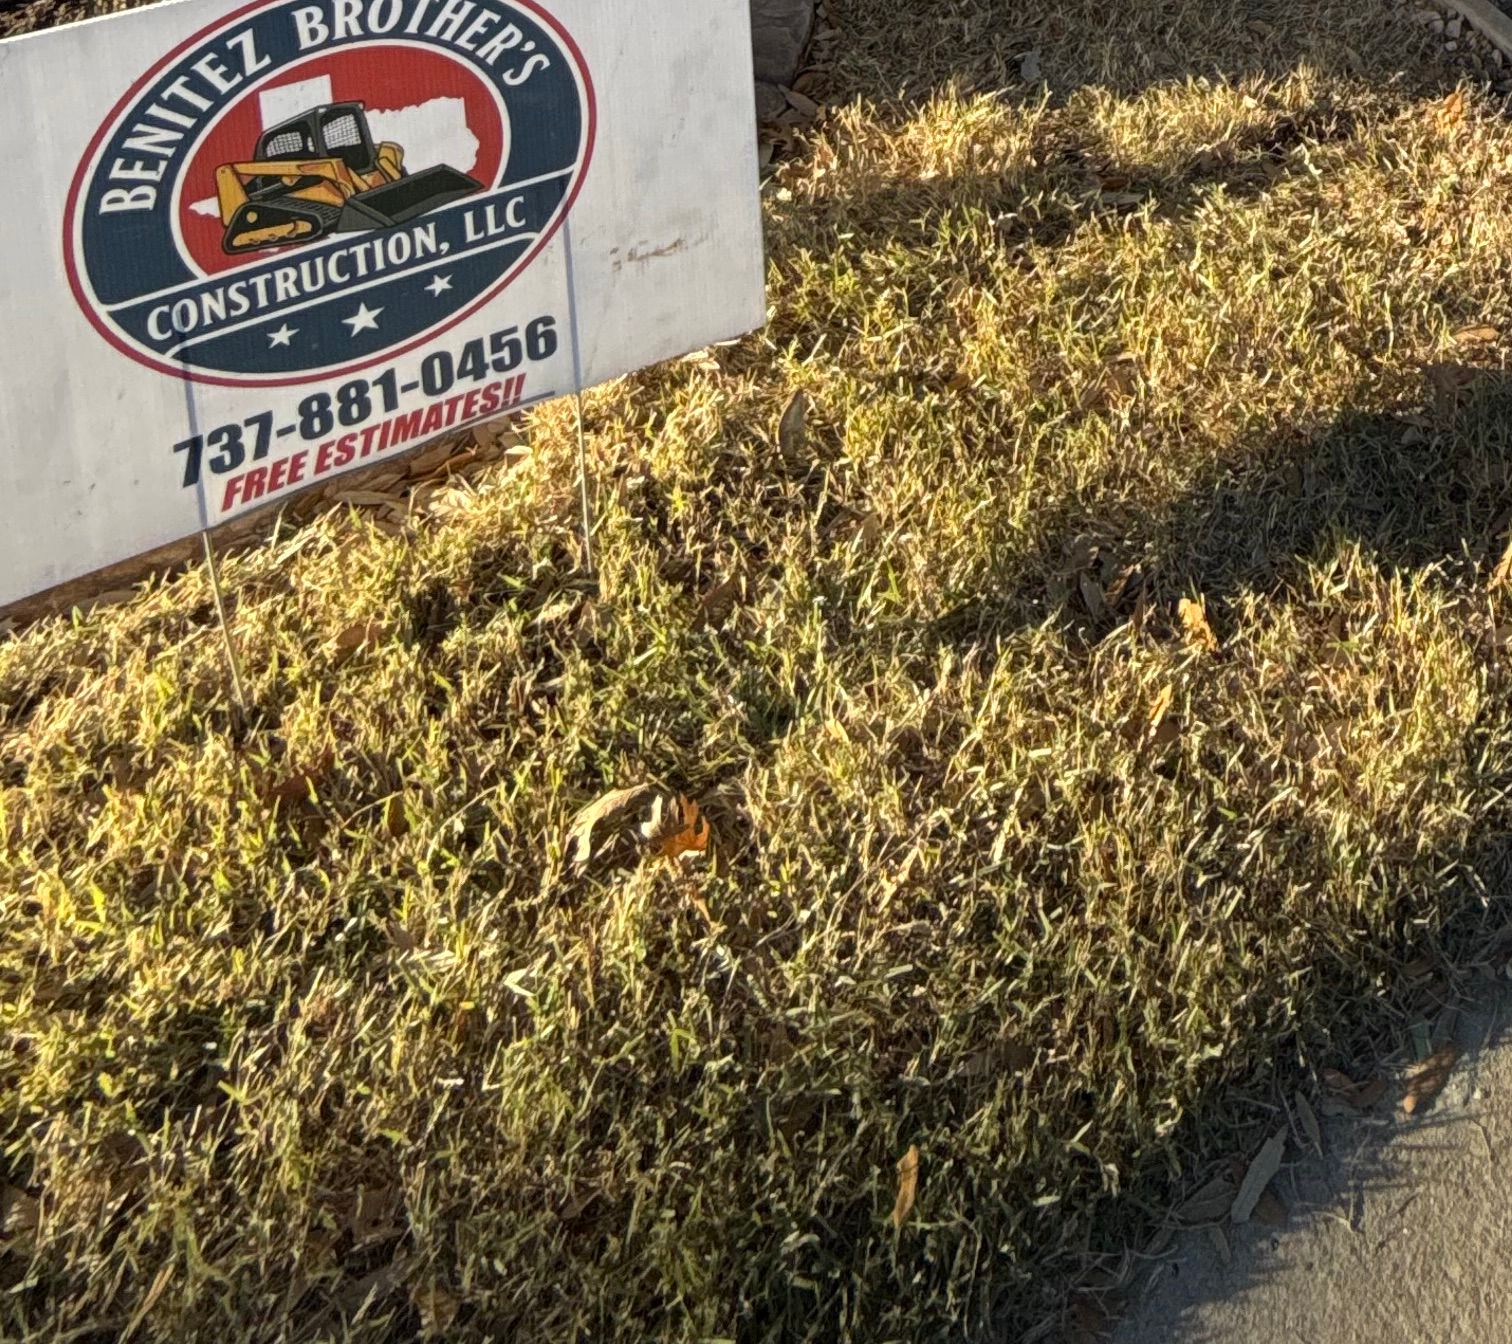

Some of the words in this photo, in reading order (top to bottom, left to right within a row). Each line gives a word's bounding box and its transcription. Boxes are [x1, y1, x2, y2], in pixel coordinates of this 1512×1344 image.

[100, 27, 272, 214] BENITEZ
[147, 222, 450, 340] CONSTRUCTION,
[463, 196, 527, 243] LLC
[173, 315, 558, 488] 737-881-0456
[221, 451, 305, 512] FREE
[314, 373, 527, 475] ESTIMATES!!
